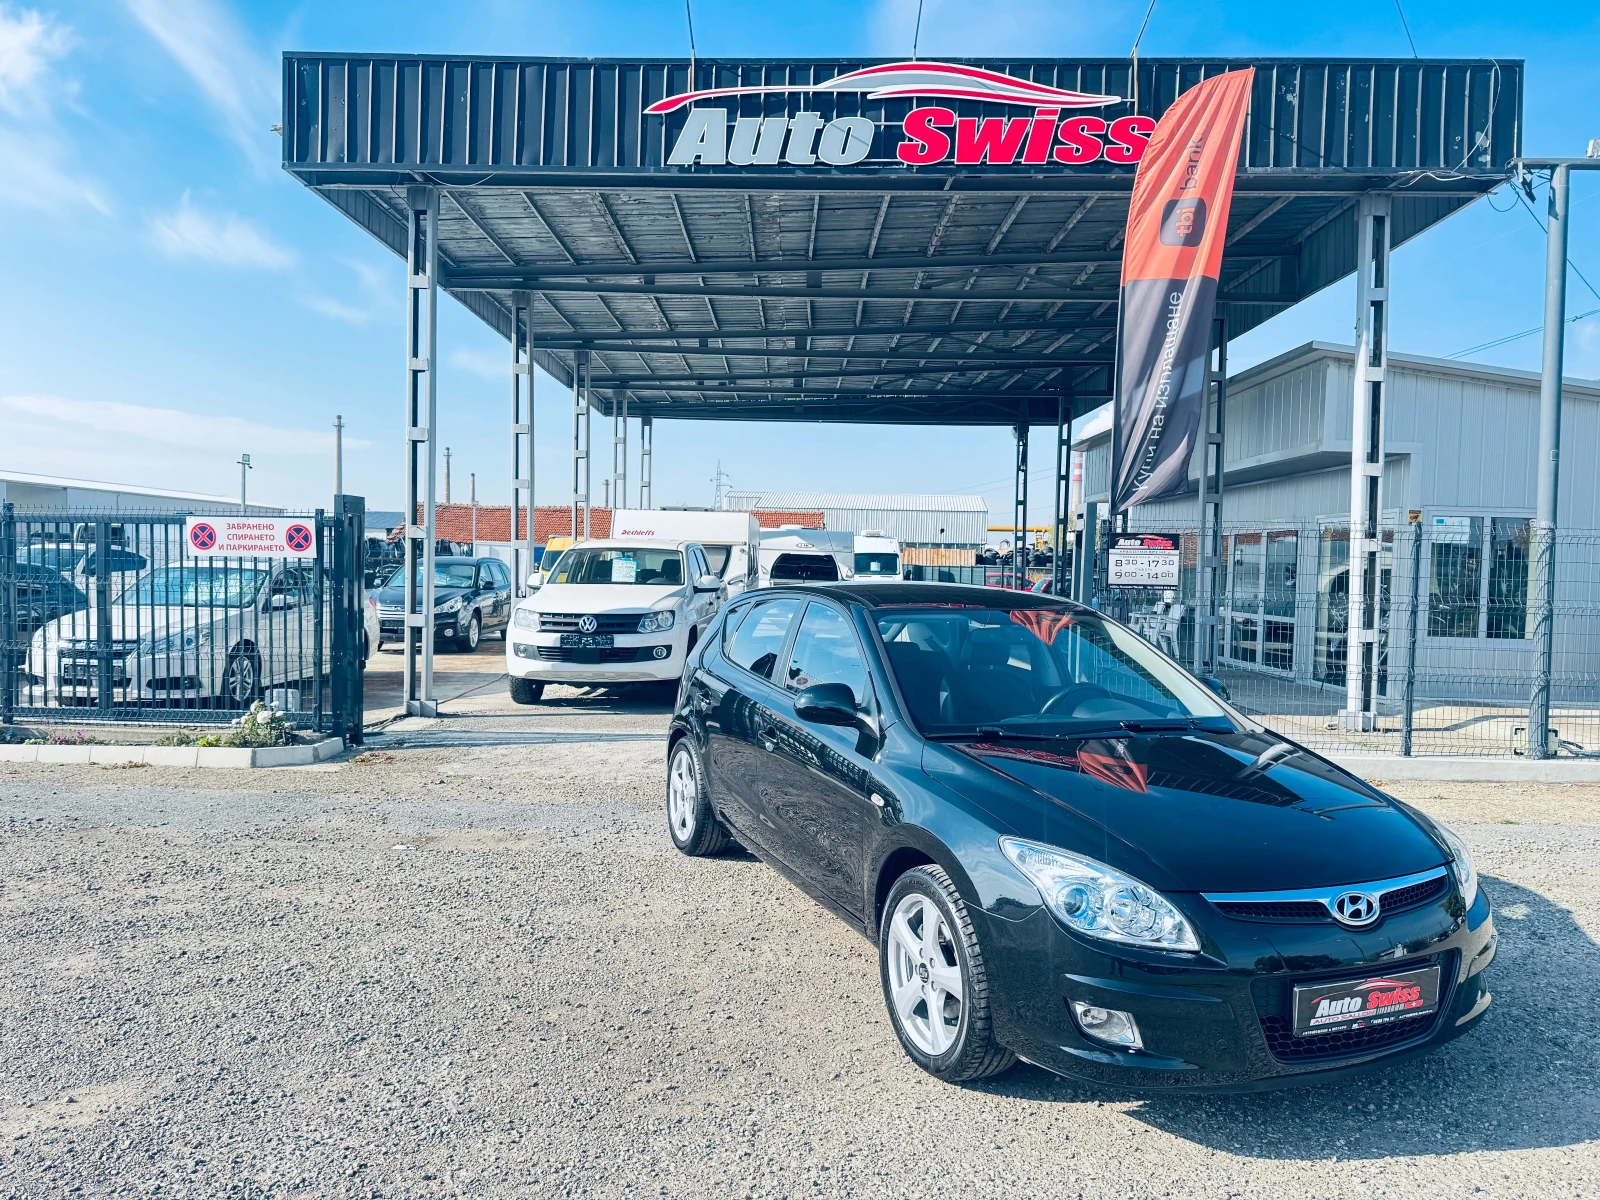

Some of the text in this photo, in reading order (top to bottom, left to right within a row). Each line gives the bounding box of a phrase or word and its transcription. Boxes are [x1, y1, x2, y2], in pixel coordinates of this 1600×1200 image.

[666, 106, 1155, 166] Auto Swiss
[1176, 137, 1203, 237] tbi bank
[1155, 291, 1184, 408] изплащане
[1150, 414, 1165, 439] на
[226, 523, 275, 531] ЗАБРАНЕНО
[226, 533, 275, 541] СПИРАНЕТО
[1117, 538, 1141, 546] Auto
[226, 544, 285, 552] ПАРКИРАНЕТО
[1315, 997, 1362, 1018] Auto
[1366, 986, 1420, 1009] Swiss
[1312, 1016, 1340, 1024] AUTO
